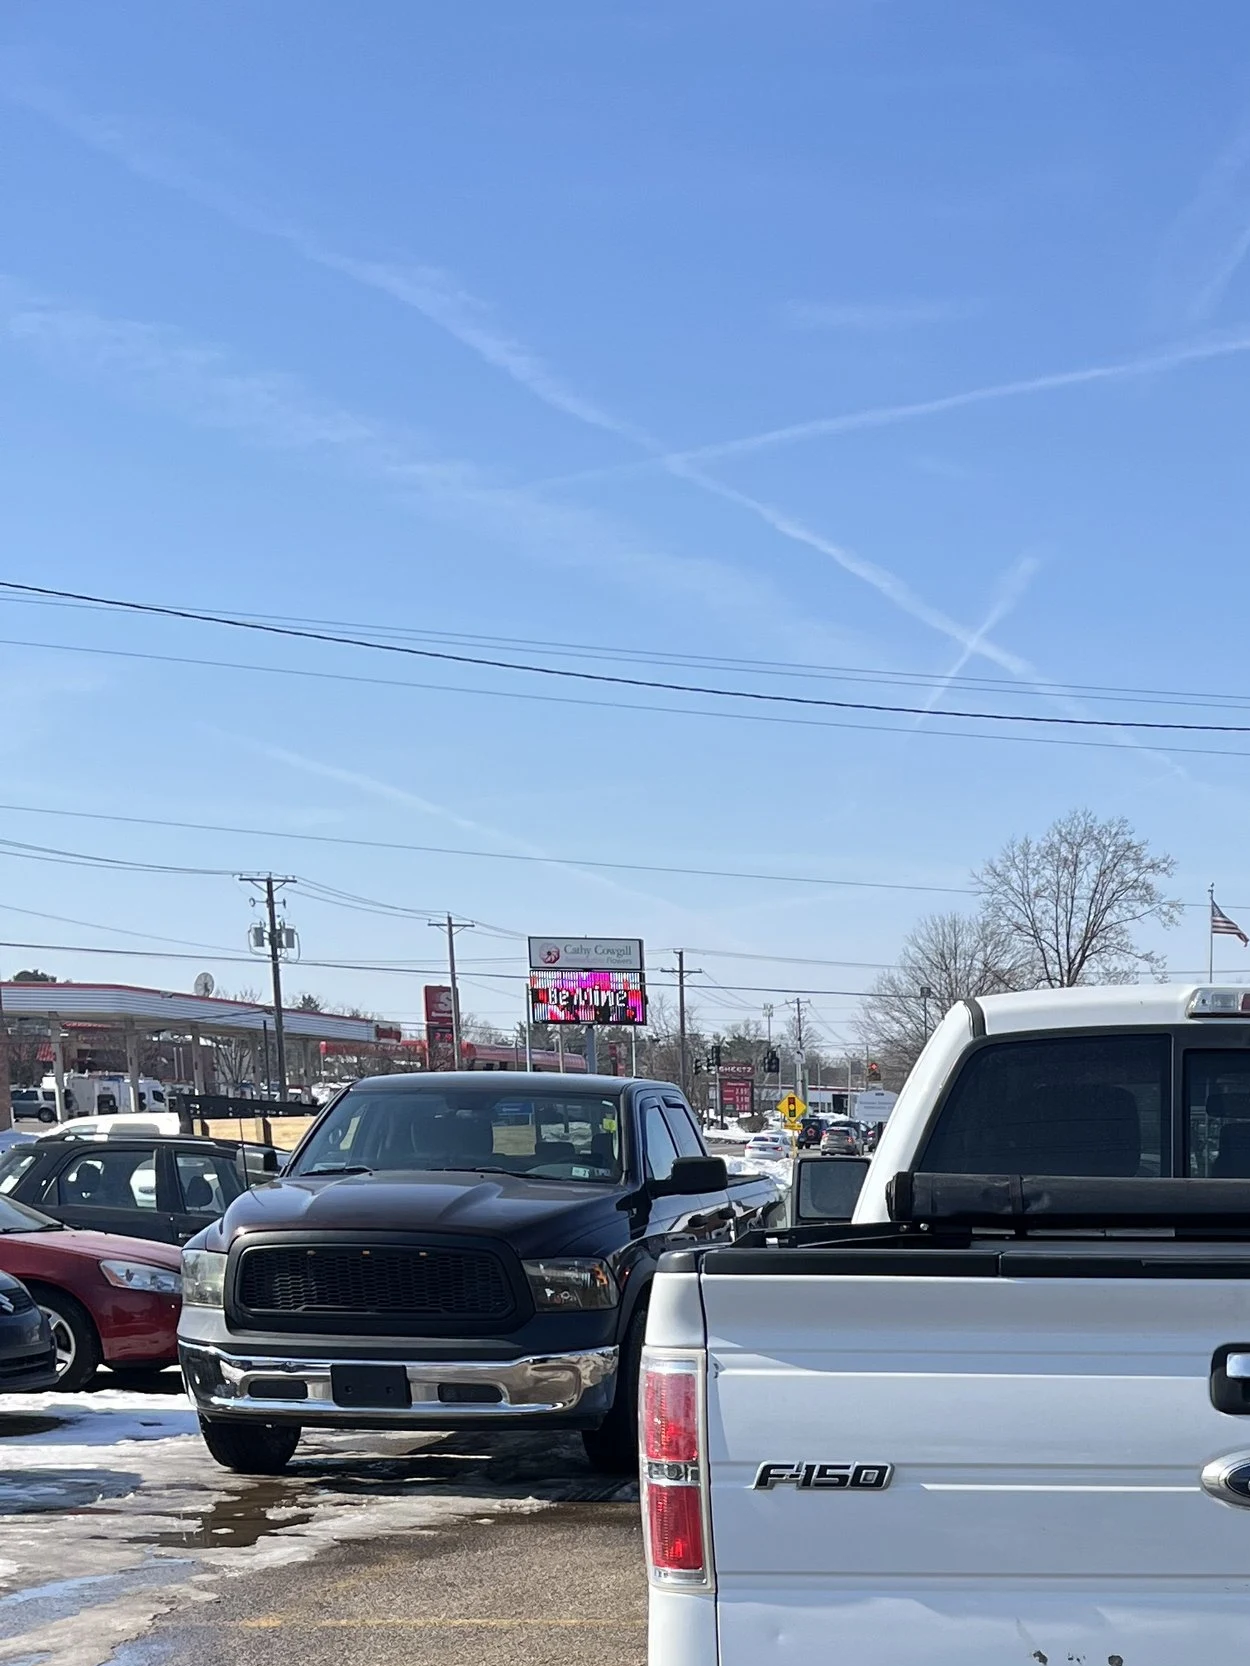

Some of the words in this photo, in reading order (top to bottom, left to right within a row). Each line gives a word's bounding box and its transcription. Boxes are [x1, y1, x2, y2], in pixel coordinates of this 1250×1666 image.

[563, 944, 592, 958] Cathy
[594, 944, 632, 958] Cowgill
[718, 1065, 752, 1073] SHEETZ
[755, 1461, 892, 1490] F-150
